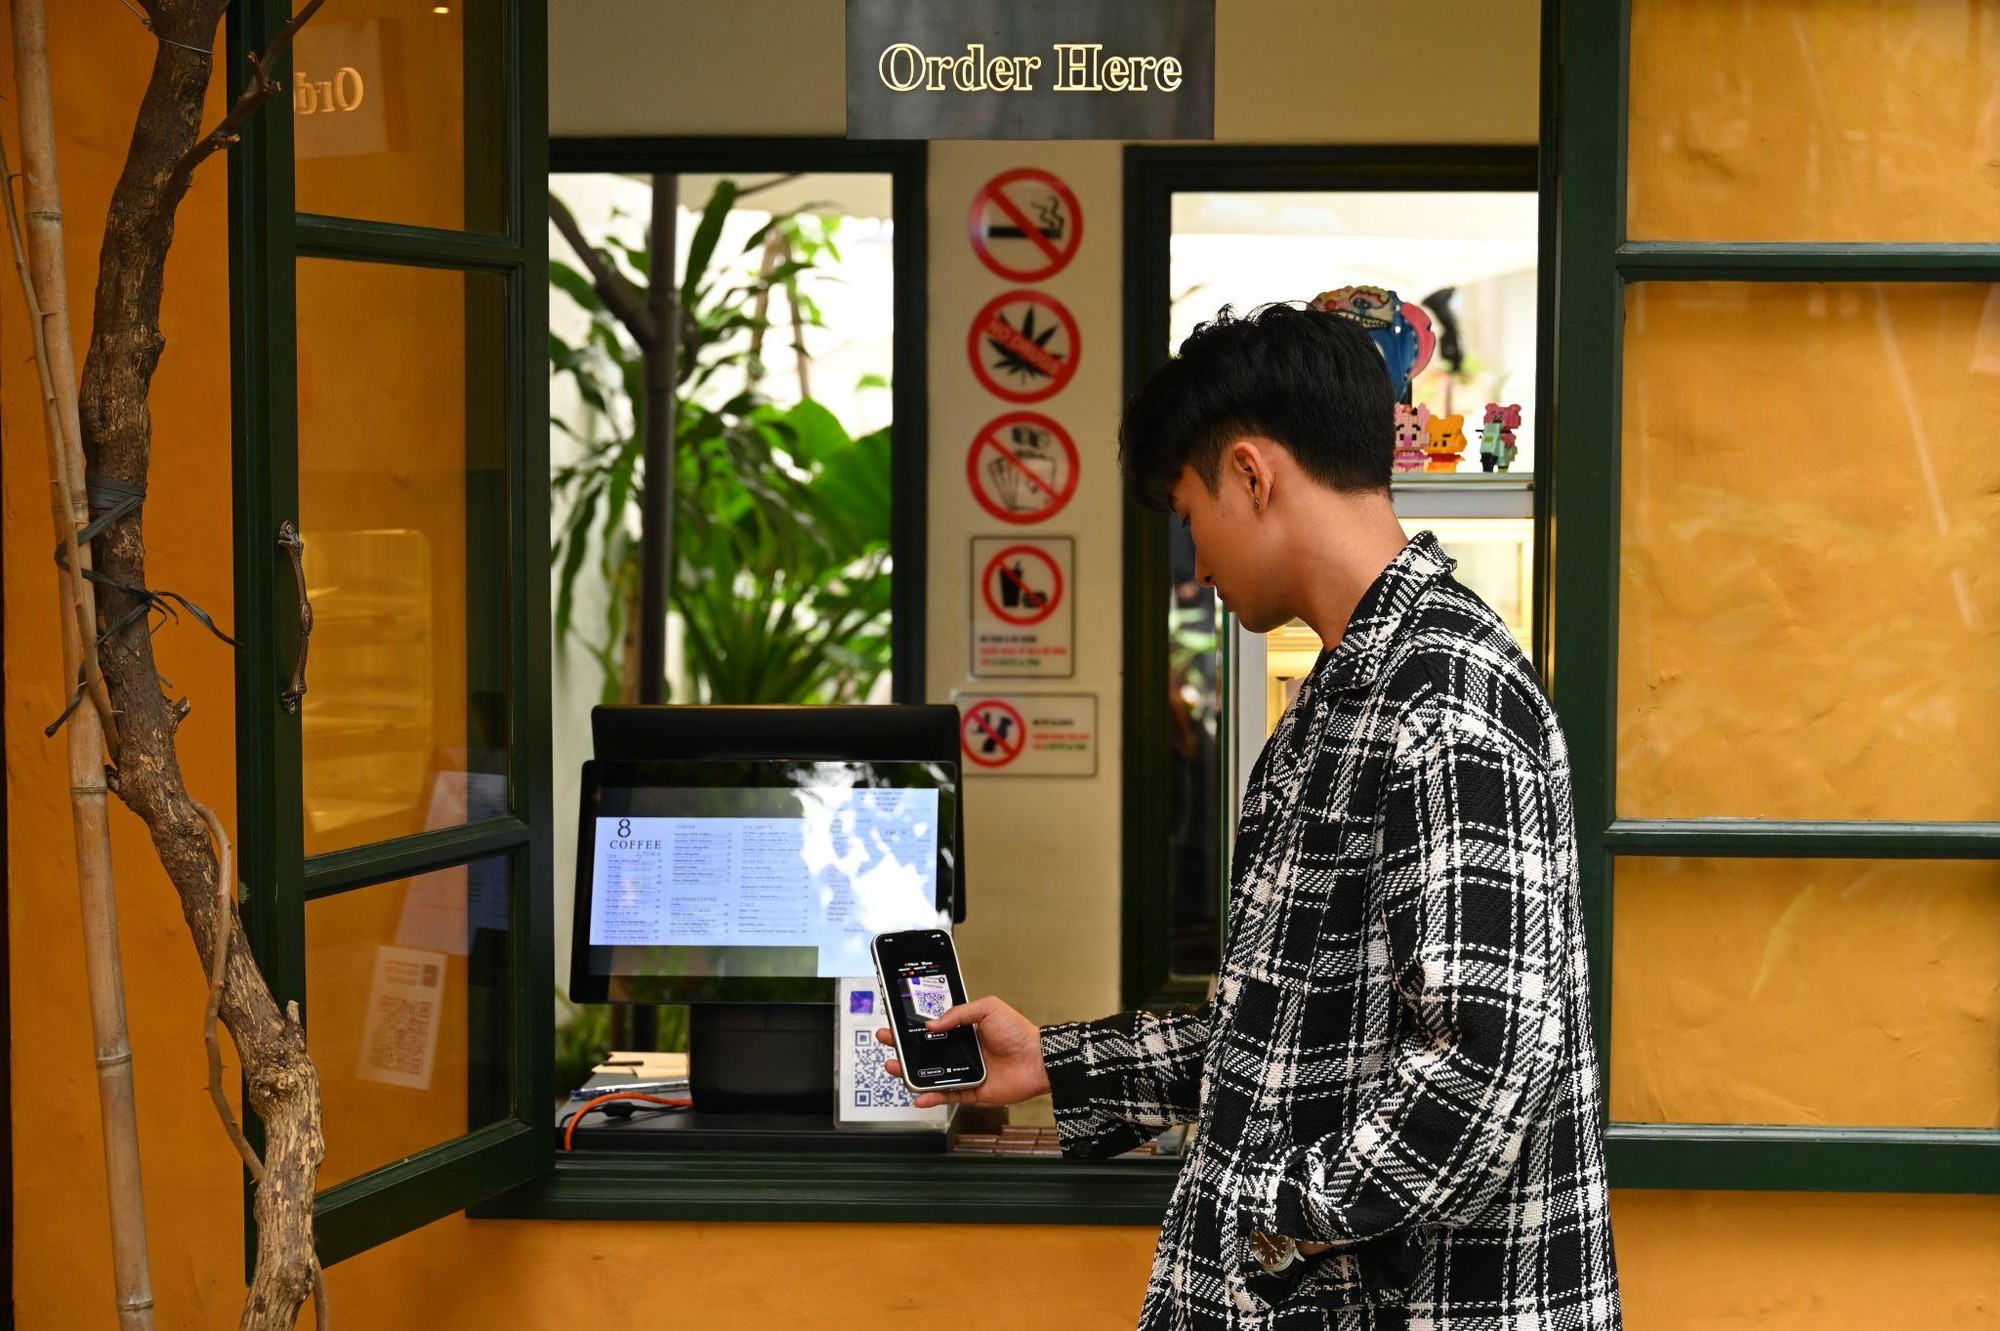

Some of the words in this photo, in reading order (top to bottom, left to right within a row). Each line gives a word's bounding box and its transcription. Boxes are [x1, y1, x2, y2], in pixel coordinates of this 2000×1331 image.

[879, 43, 1041, 92] Order
[1053, 44, 1183, 92] Here
[617, 818, 631, 838] 8
[609, 839, 662, 850] COFFEE
